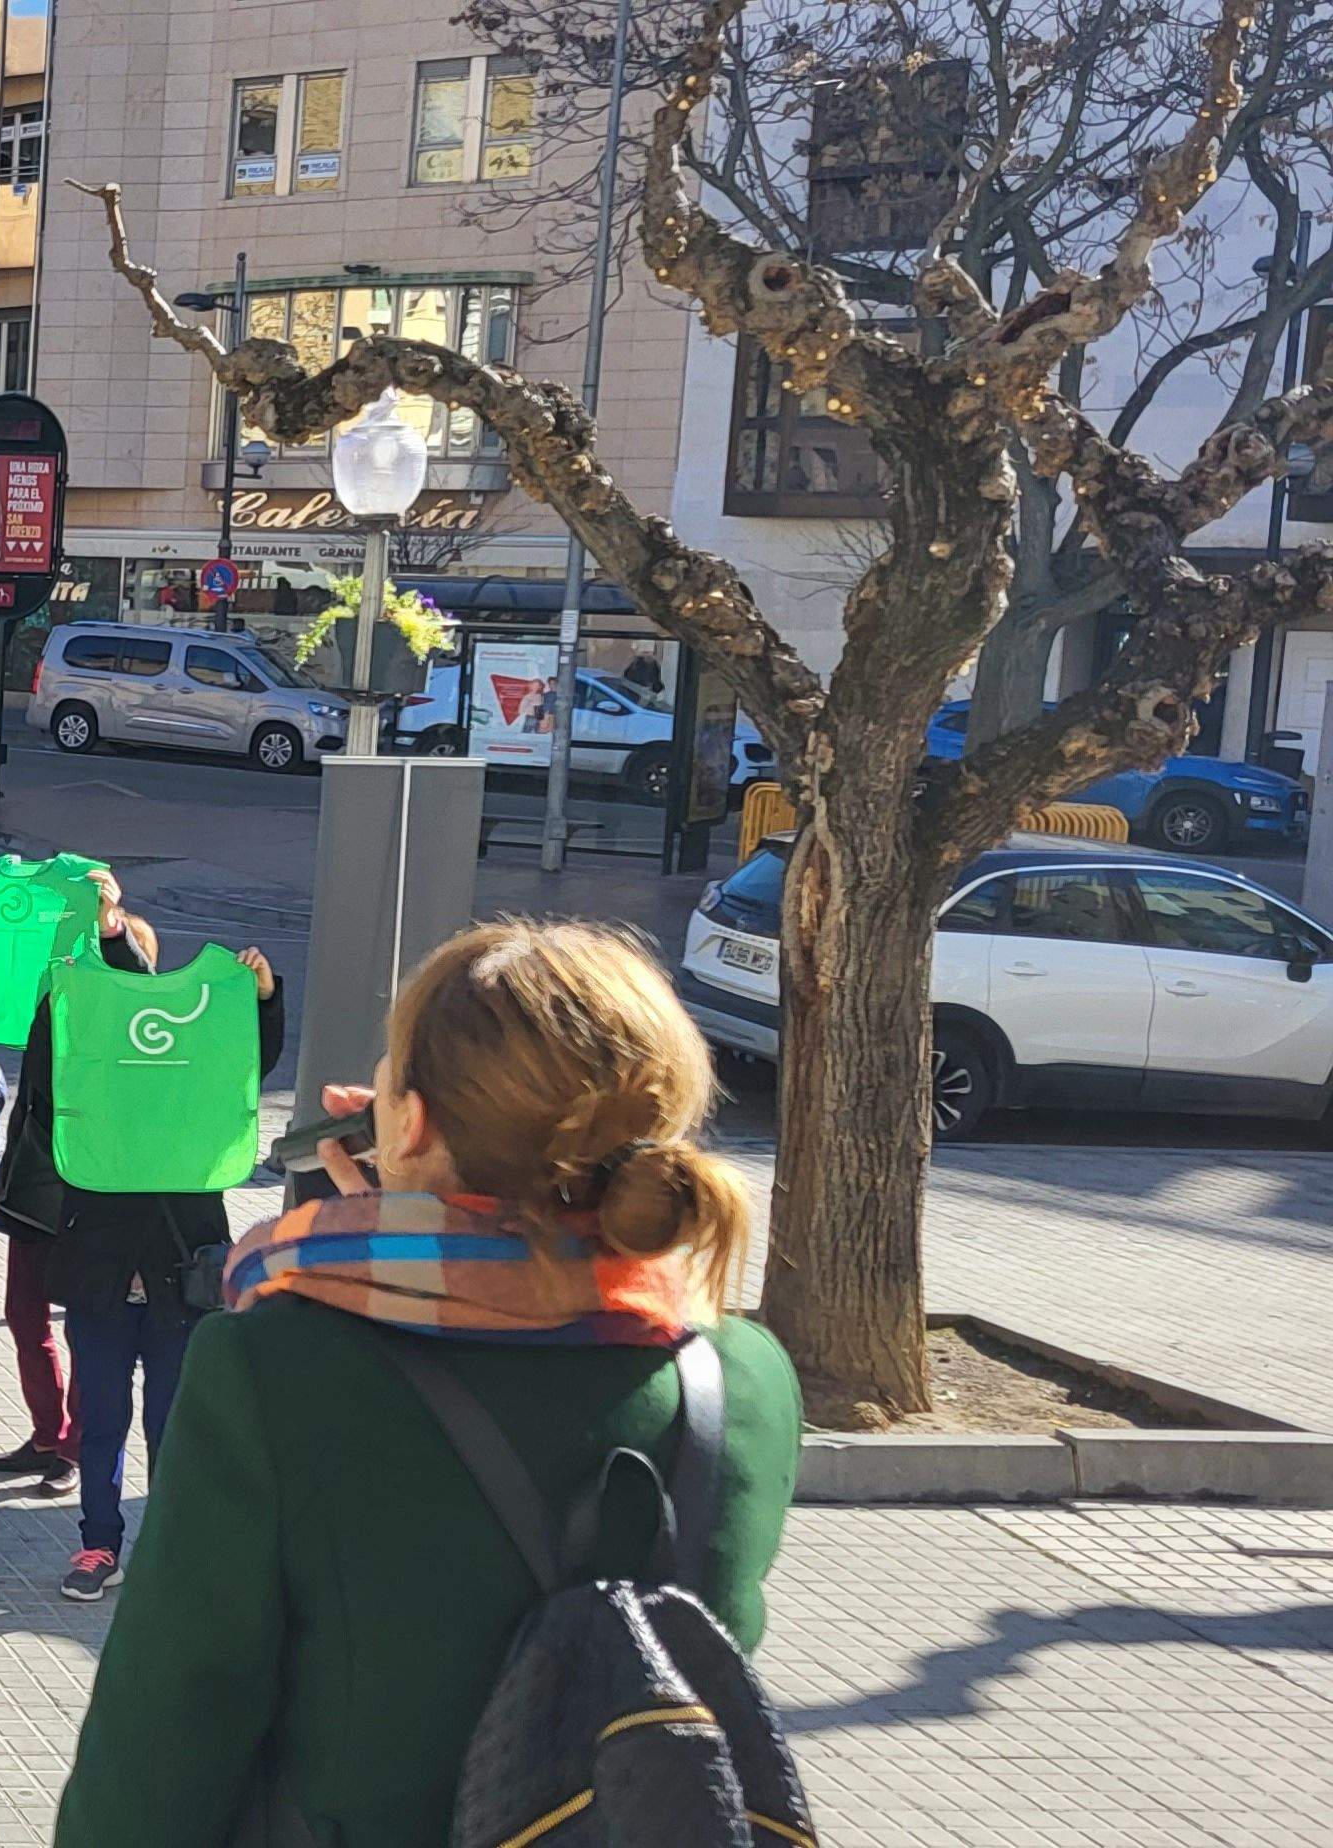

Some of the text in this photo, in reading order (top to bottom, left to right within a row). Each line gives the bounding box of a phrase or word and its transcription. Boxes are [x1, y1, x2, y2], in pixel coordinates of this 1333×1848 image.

[7, 487, 30, 499] PARA
[218, 491, 481, 530] Cafeía
[6, 513, 24, 525] SAN
[231, 546, 301, 557] STAURANTE
